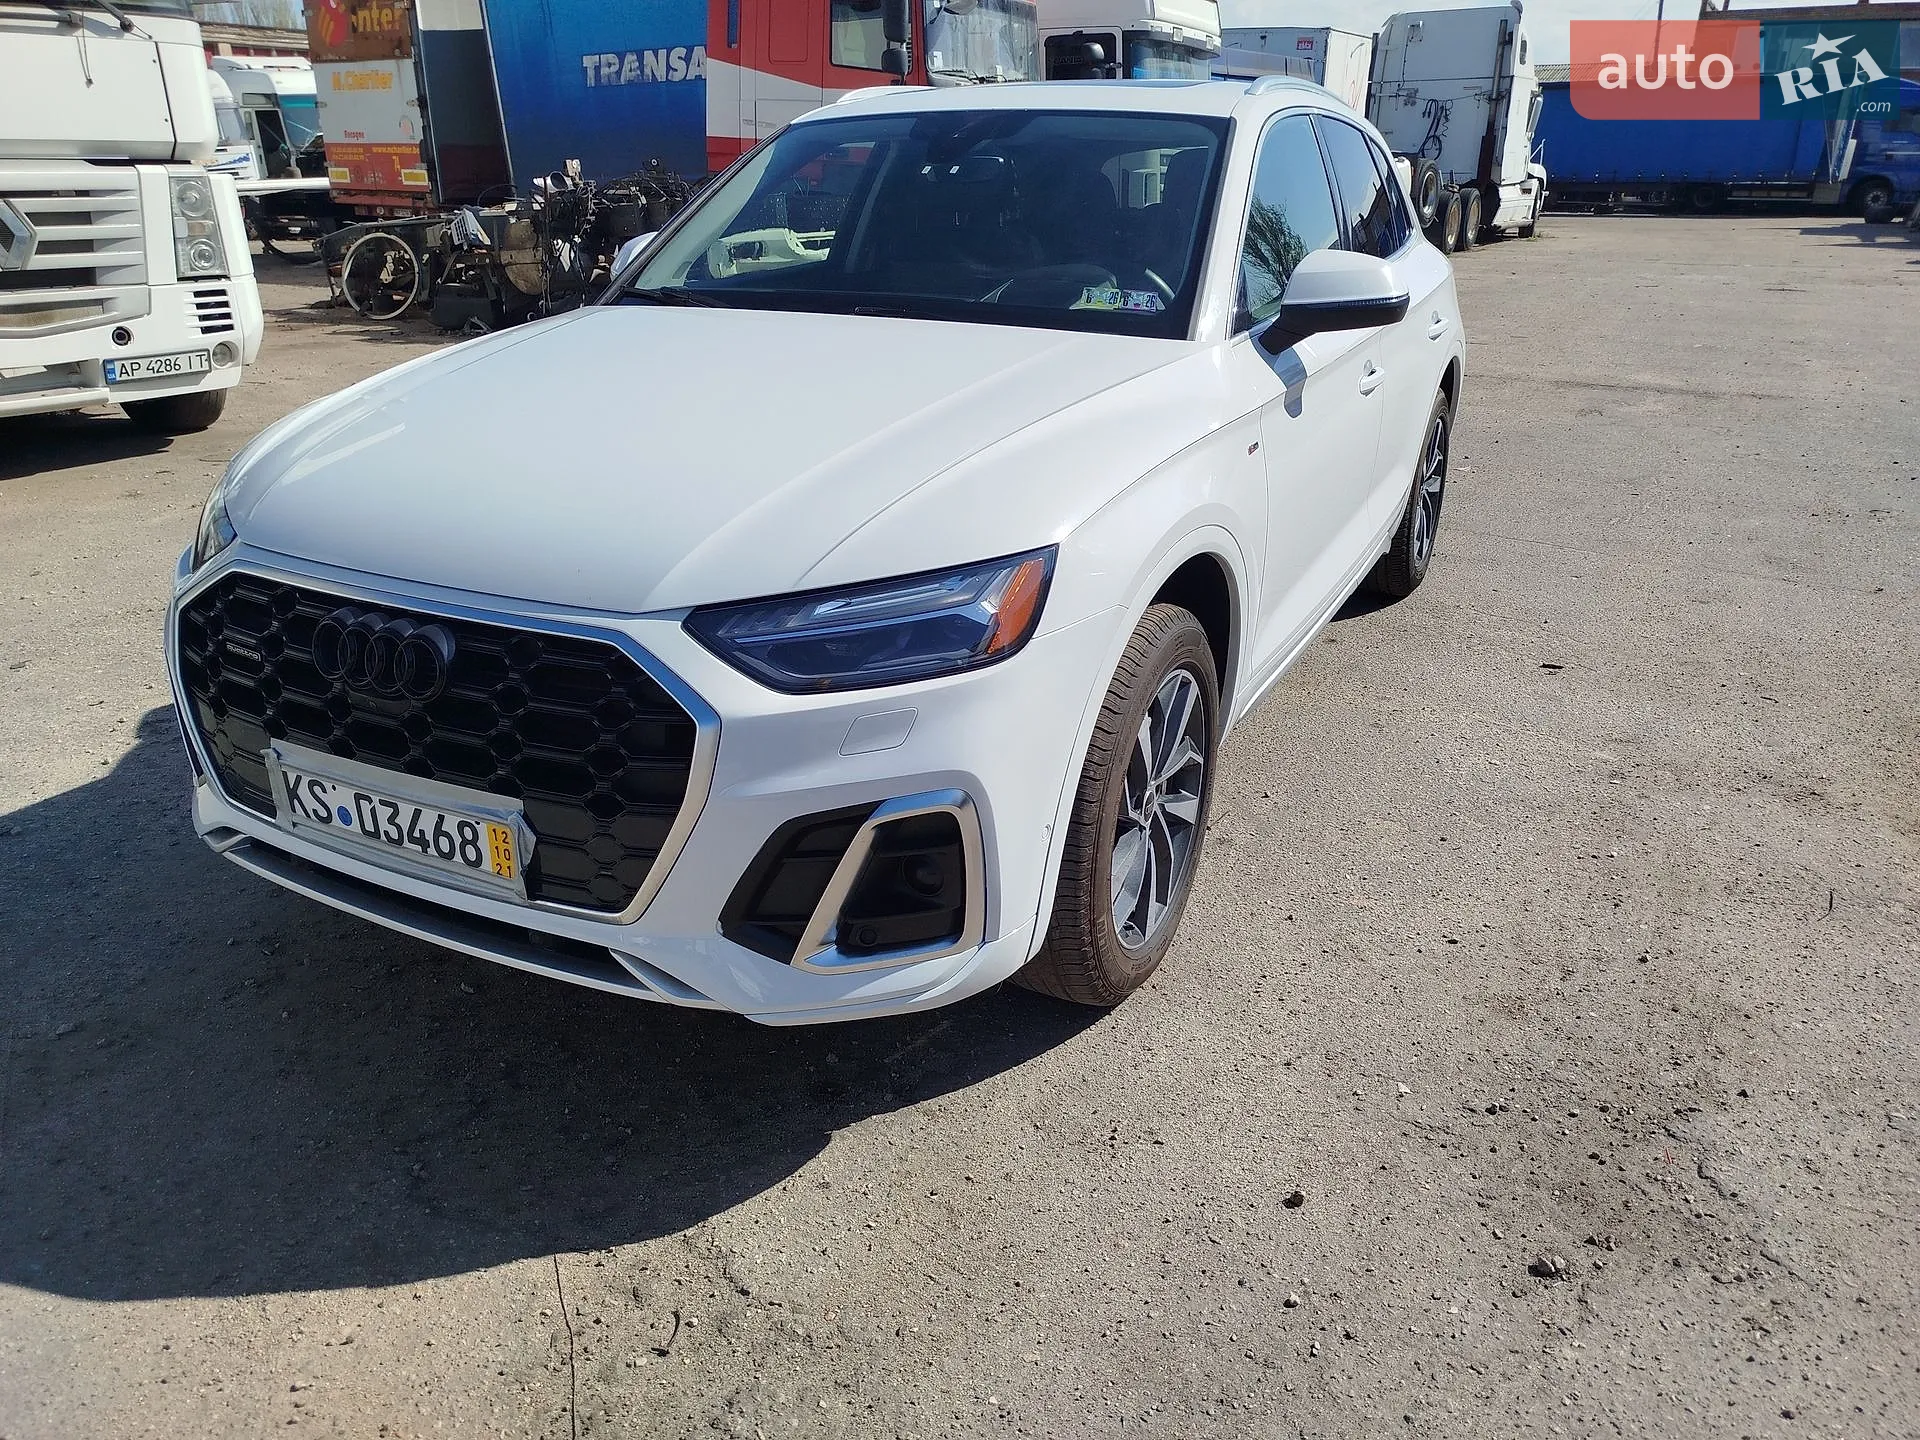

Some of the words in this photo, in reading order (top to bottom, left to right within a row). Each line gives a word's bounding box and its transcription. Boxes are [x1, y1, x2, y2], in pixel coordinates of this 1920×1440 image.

[582, 45, 707, 88] TRANSA
[119, 361, 142, 378] AP
[146, 356, 182, 375] 4286
[187, 353, 207, 370] IT
[282, 770, 333, 825] KS
[353, 792, 484, 869] 03468
[491, 827, 510, 845] 12
[494, 845, 512, 862] 10
[496, 862, 513, 879] 21
